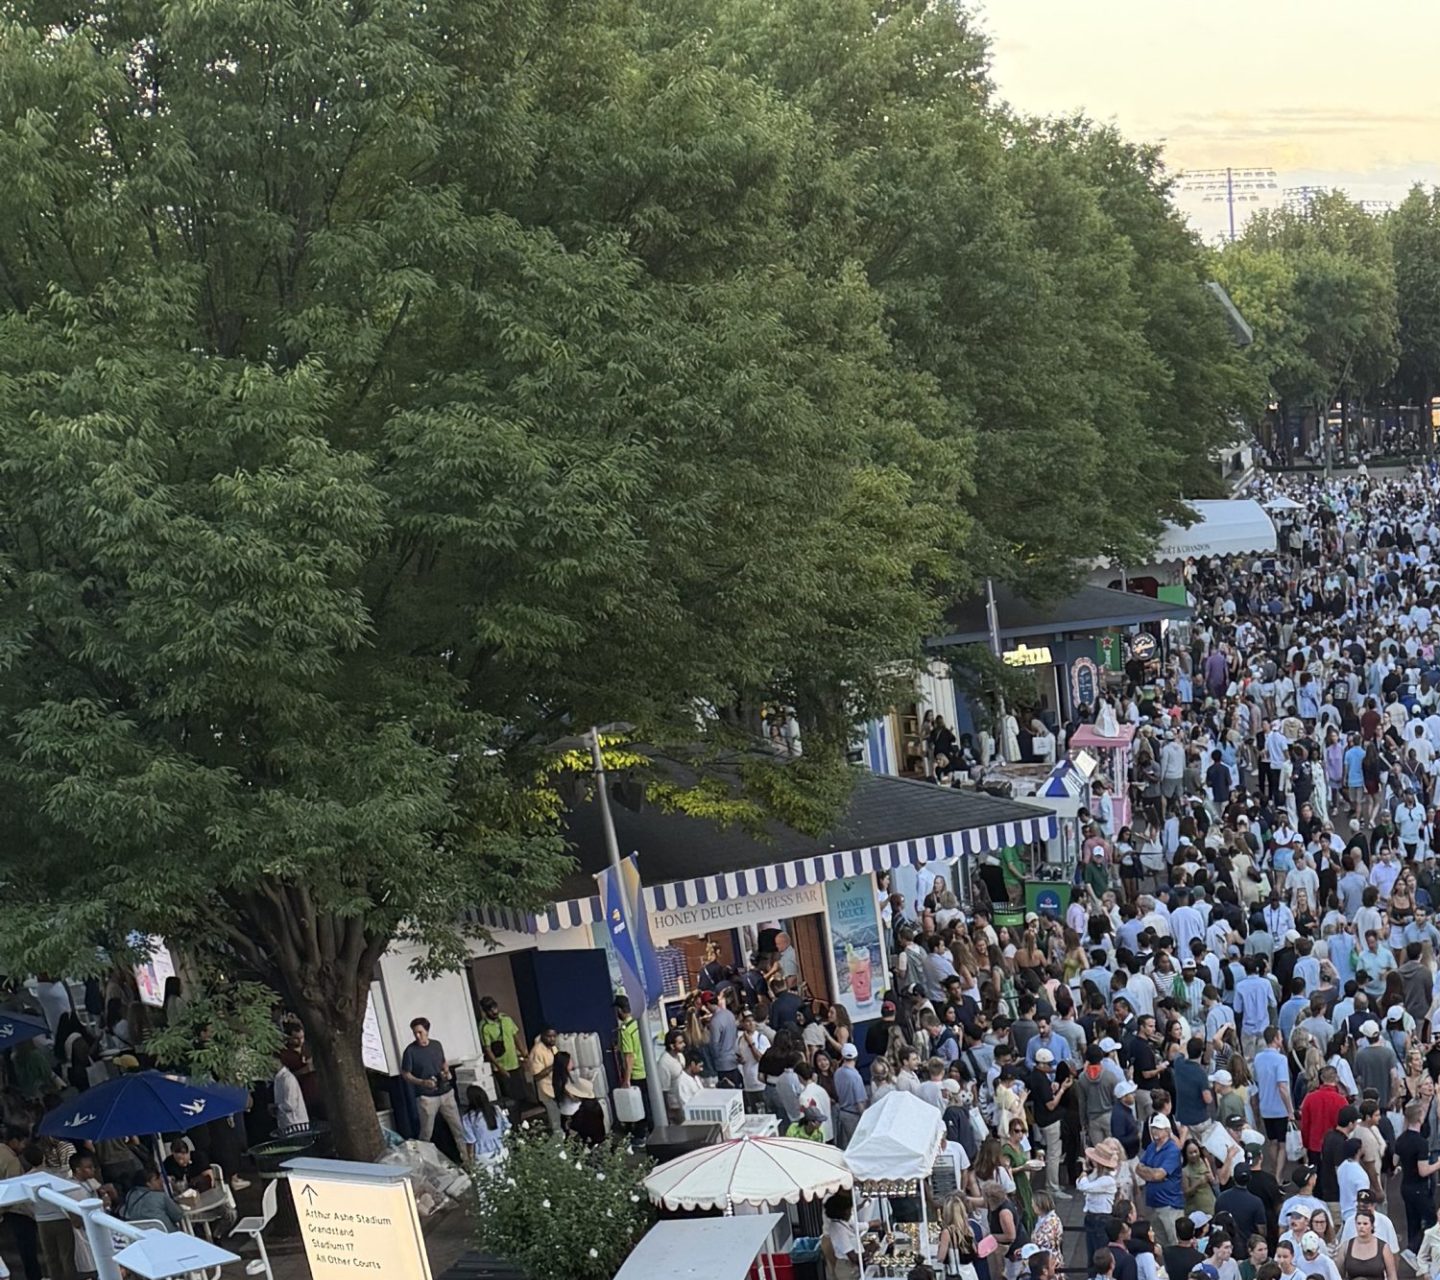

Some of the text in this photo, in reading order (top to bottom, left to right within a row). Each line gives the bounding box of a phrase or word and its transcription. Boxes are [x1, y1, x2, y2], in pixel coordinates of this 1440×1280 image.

[655, 889, 818, 929] HONEY DEUCE EXPRESS BAR
[837, 897, 865, 910] HONEY
[838, 906, 865, 919] DEUCE
[305, 1208, 391, 1226] Arthur Ashe Stadium
[308, 1224, 354, 1238] Grandstand
[311, 1238, 354, 1252] Stadium 17
[316, 1253, 381, 1270] All Other Courts
